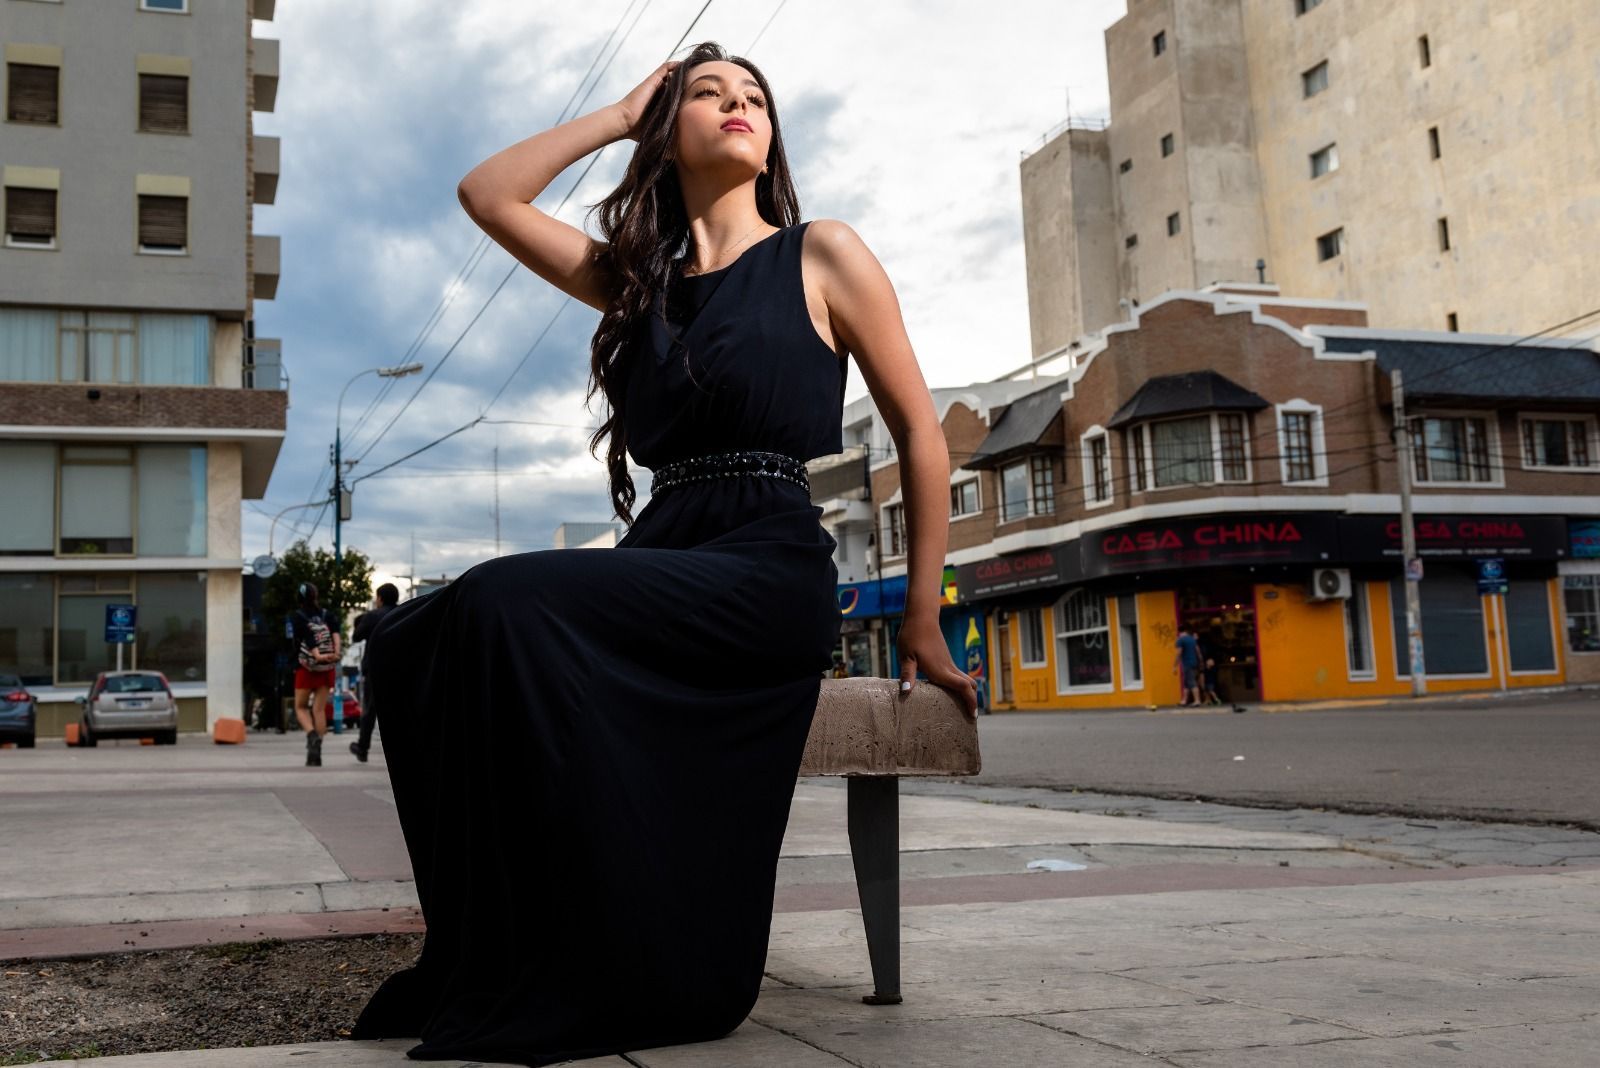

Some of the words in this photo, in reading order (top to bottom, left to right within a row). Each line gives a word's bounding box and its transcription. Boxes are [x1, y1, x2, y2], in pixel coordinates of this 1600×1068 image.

[1103, 529, 1184, 555] CASA
[1193, 521, 1302, 545] CHINA
[1386, 521, 1452, 539] CSA
[1459, 521, 1524, 538] CHINA
[975, 560, 1012, 580] CASA
[1014, 552, 1056, 574] CHINA
